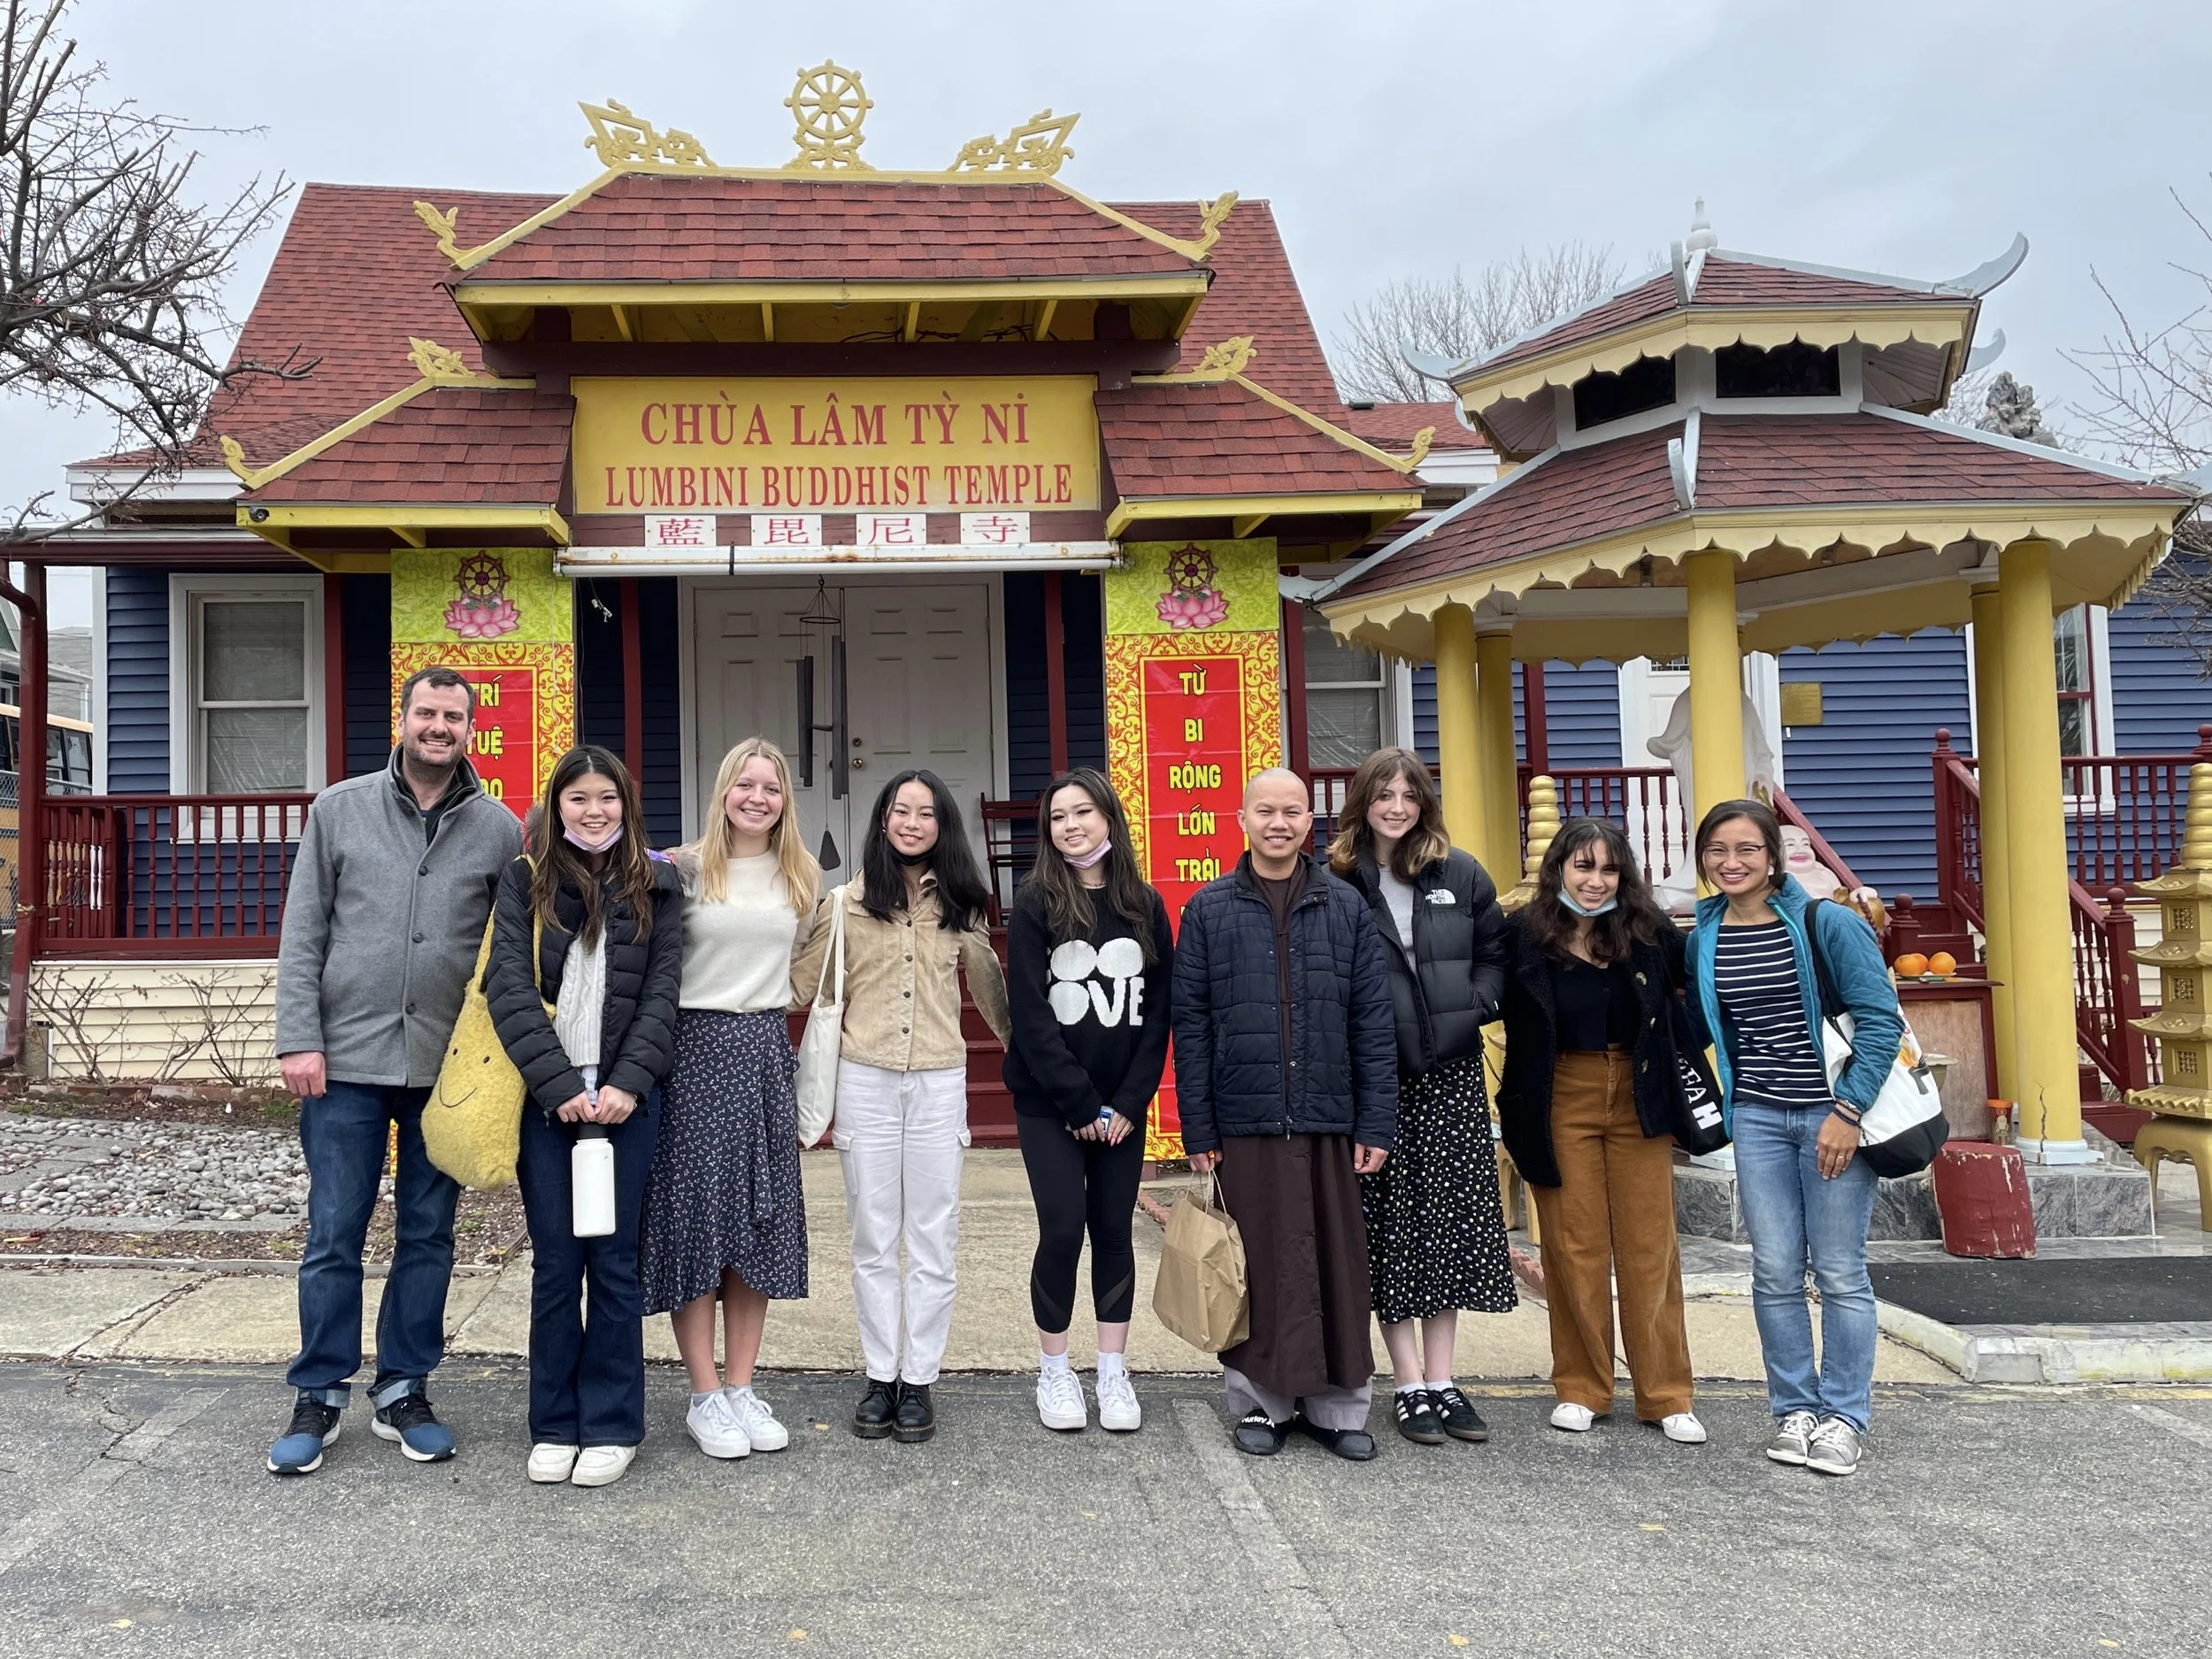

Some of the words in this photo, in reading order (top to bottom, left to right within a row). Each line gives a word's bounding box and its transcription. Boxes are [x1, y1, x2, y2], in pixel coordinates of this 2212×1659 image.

[641, 390, 772, 445] CHÙA
[790, 392, 887, 446] LÂM
[904, 390, 960, 444] TỲ
[605, 467, 749, 507] LUMBINI
[761, 465, 930, 507] BUDDHIST
[944, 464, 1071, 504] TEMPLE
[1178, 663, 1208, 695] TỪ
[1184, 718, 1204, 742] BI
[1169, 760, 1222, 794] RỘNG
[1177, 803, 1217, 835] LỚN
